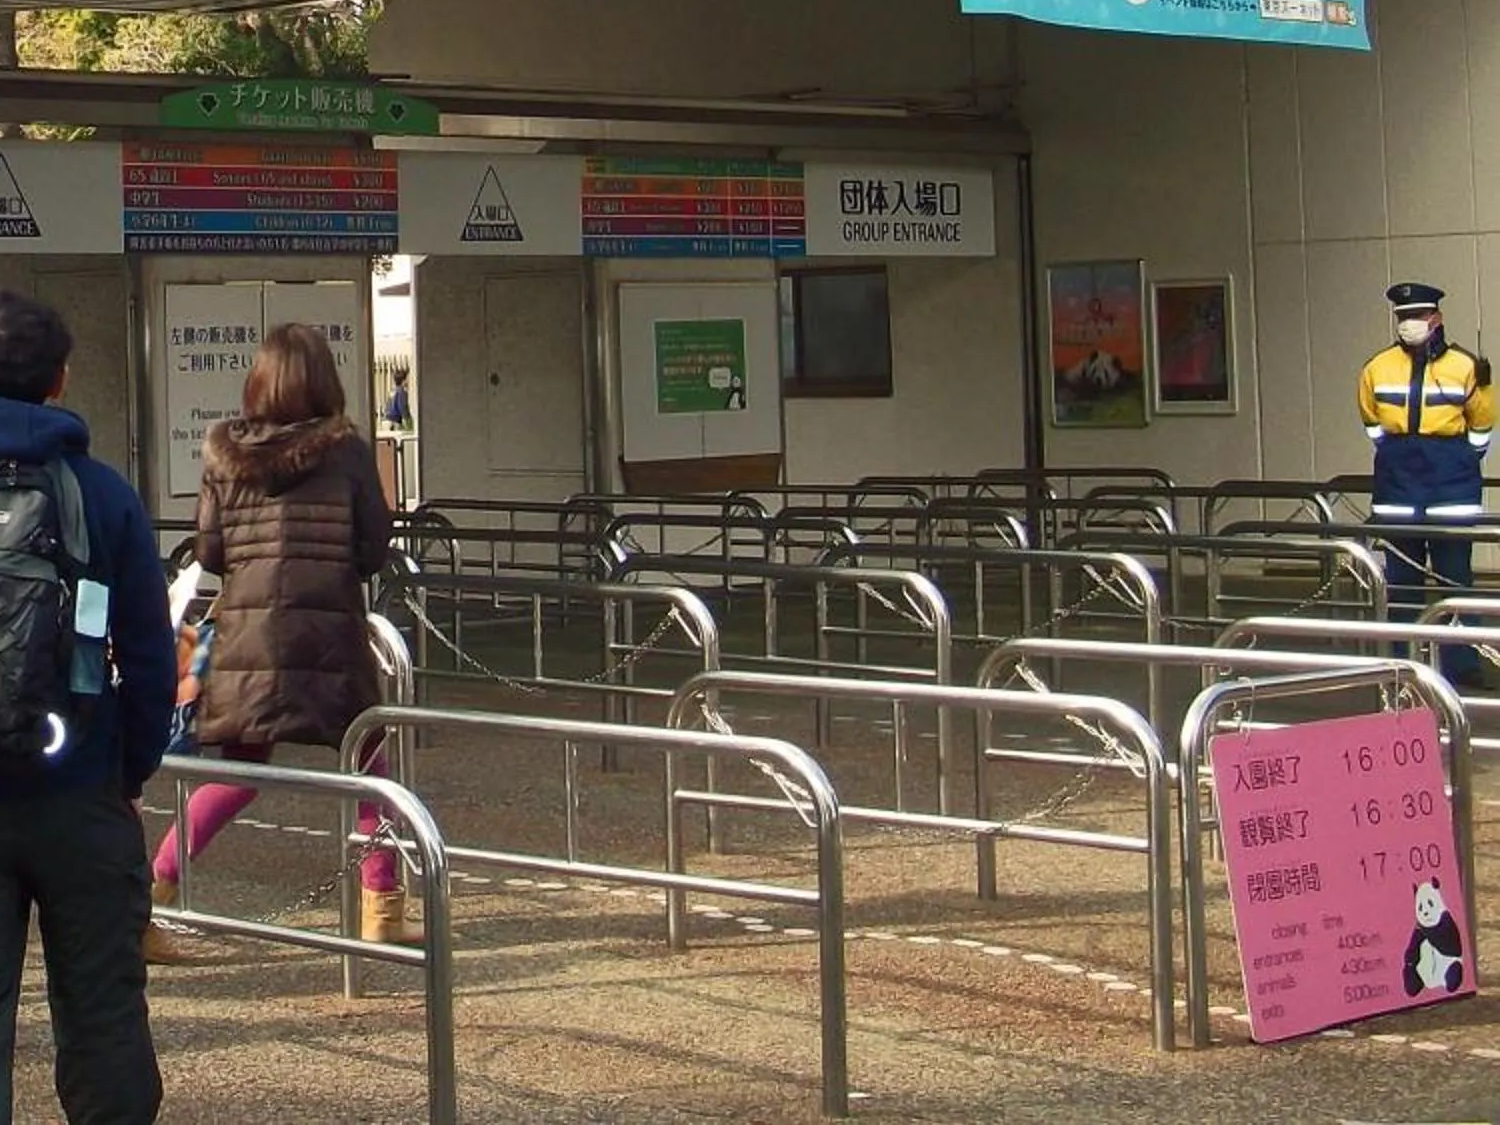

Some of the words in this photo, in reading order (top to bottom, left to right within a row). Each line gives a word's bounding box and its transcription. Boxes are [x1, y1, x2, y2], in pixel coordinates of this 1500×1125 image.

[229, 82, 377, 115] チケット販売機
[839, 179, 962, 217] 団体入場口
[842, 221, 890, 242] GROUP
[893, 221, 962, 243] ENTRANCE
[1231, 755, 1301, 794] 入園終了
[1341, 737, 1427, 774] 16:00
[1350, 789, 1434, 828] 16:30
[1239, 809, 1310, 849] 観覧終了
[1358, 842, 1442, 883] 17:00
